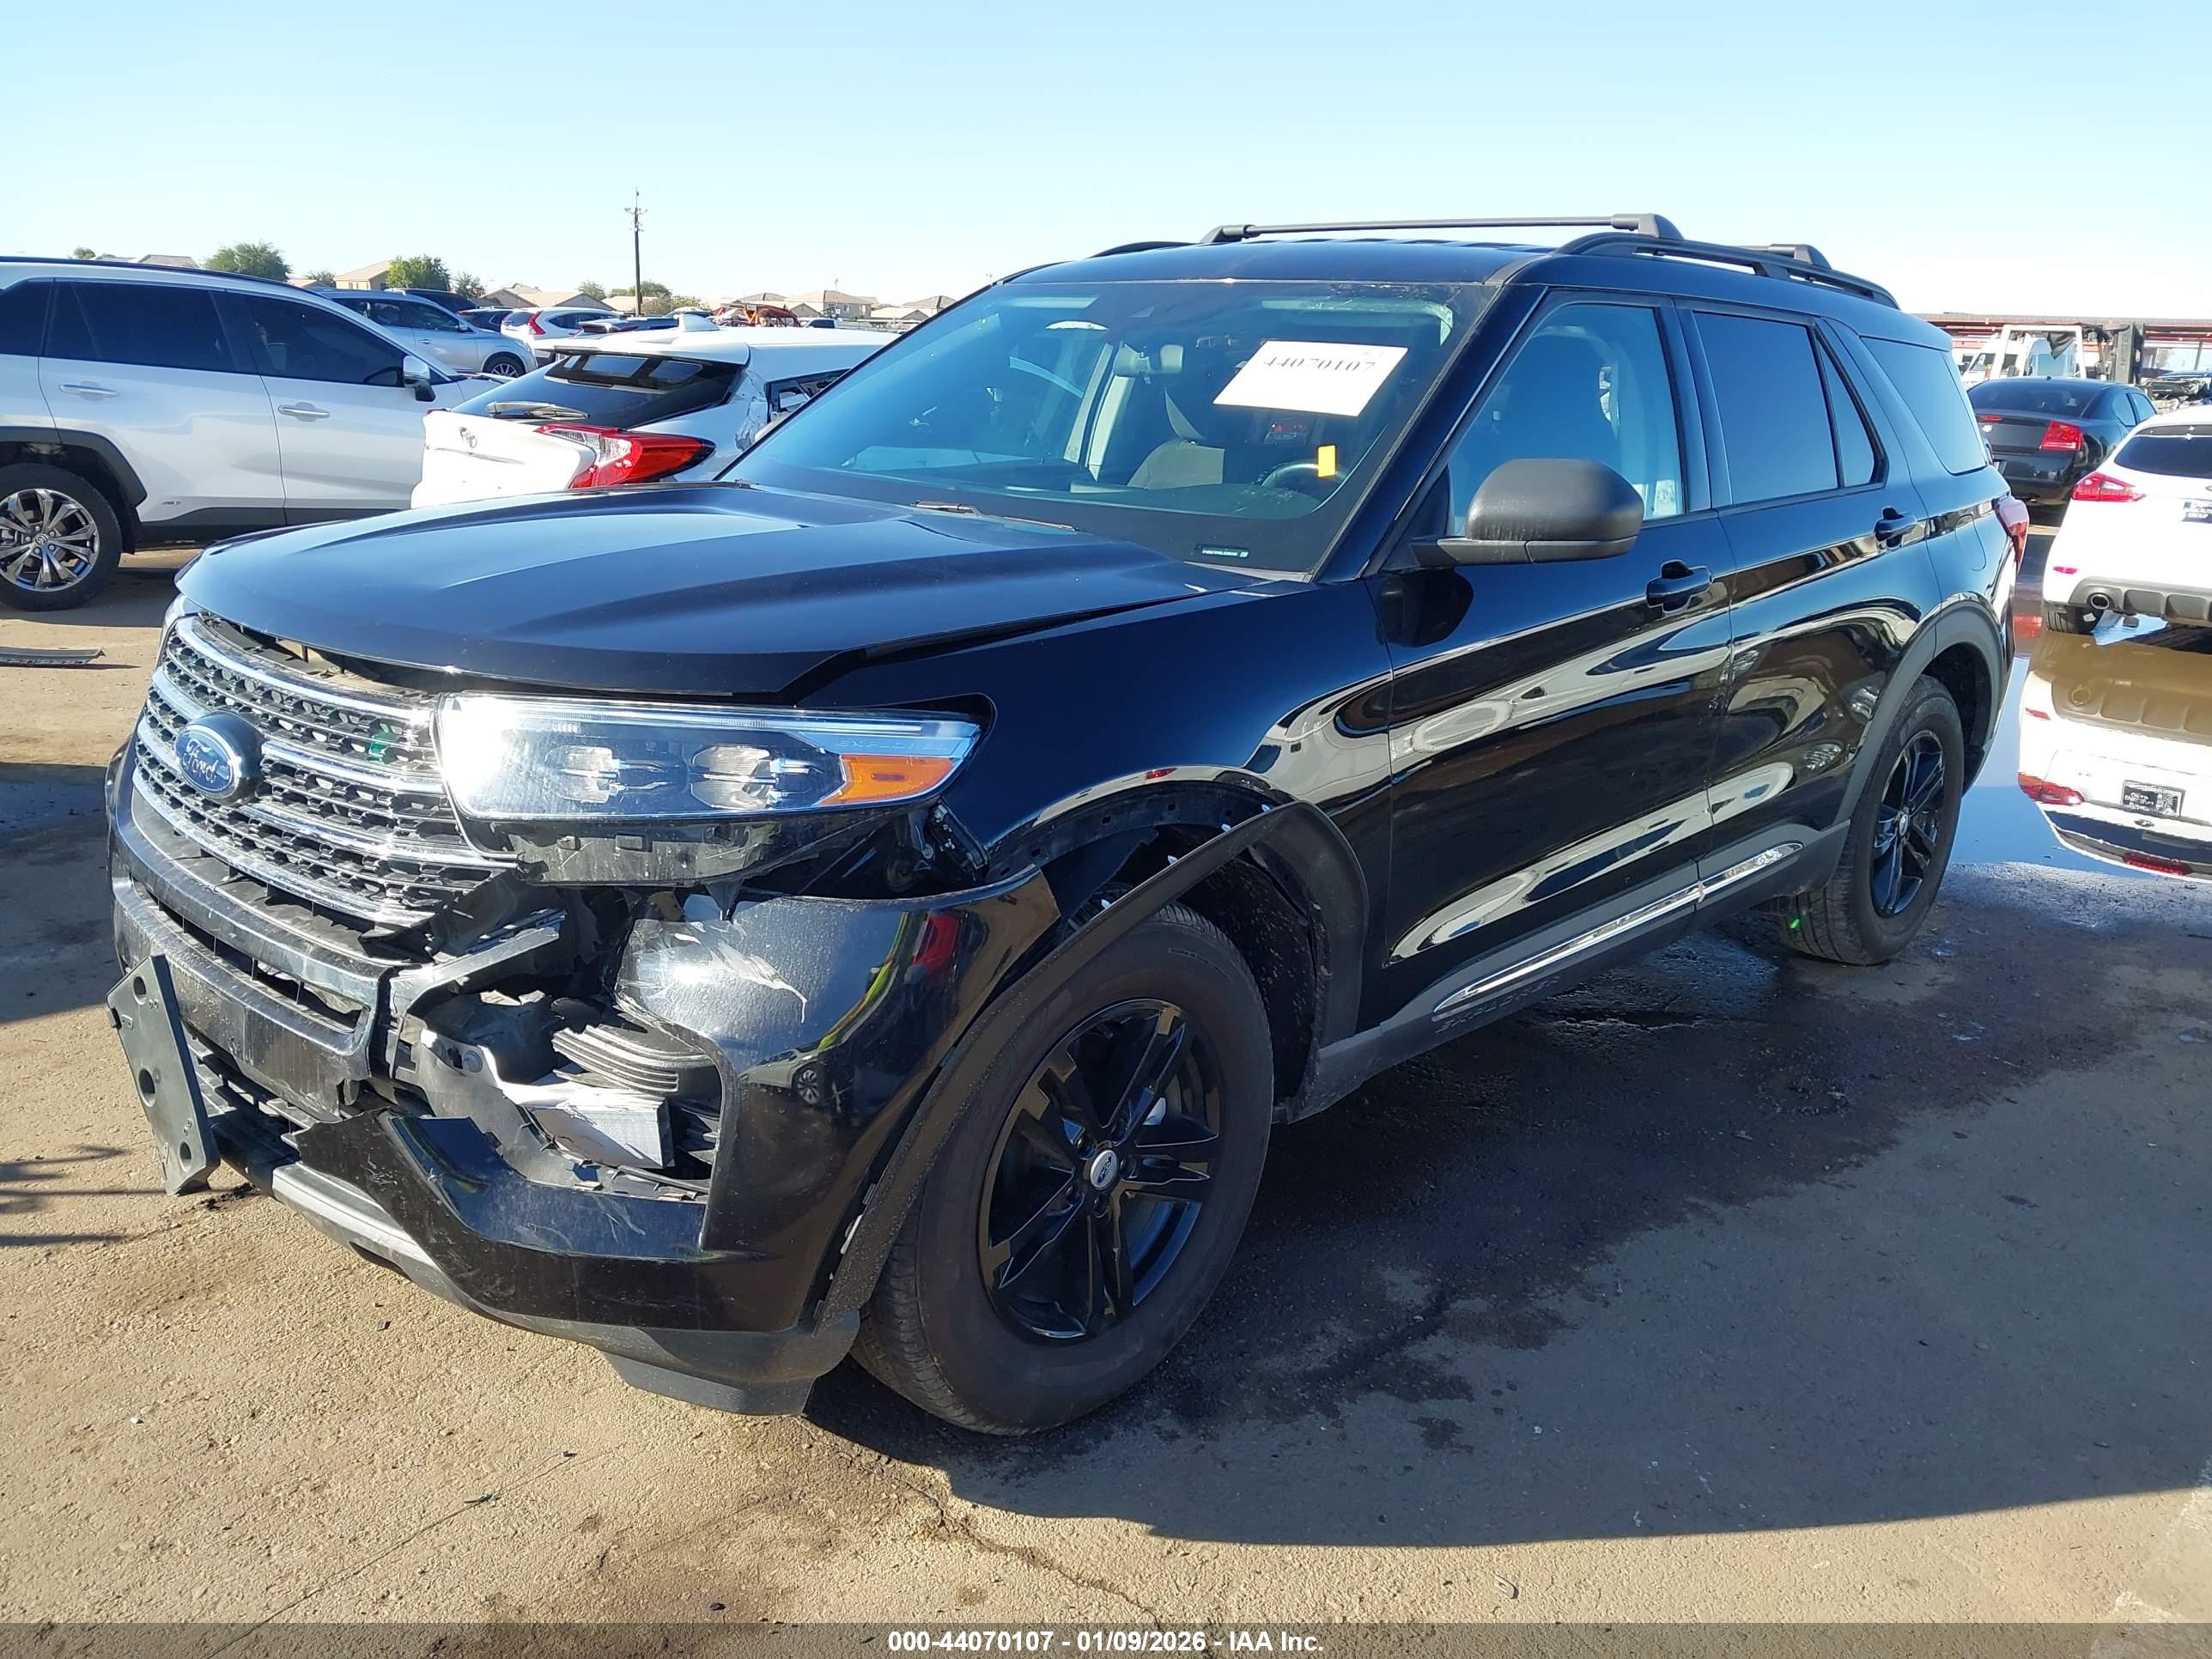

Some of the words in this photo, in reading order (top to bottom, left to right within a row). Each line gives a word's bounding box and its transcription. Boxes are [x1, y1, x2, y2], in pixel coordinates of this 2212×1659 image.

[1263, 356, 1376, 372] 44070107
[836, 739, 950, 751] EXPLOR
[182, 738, 220, 784] Ford
